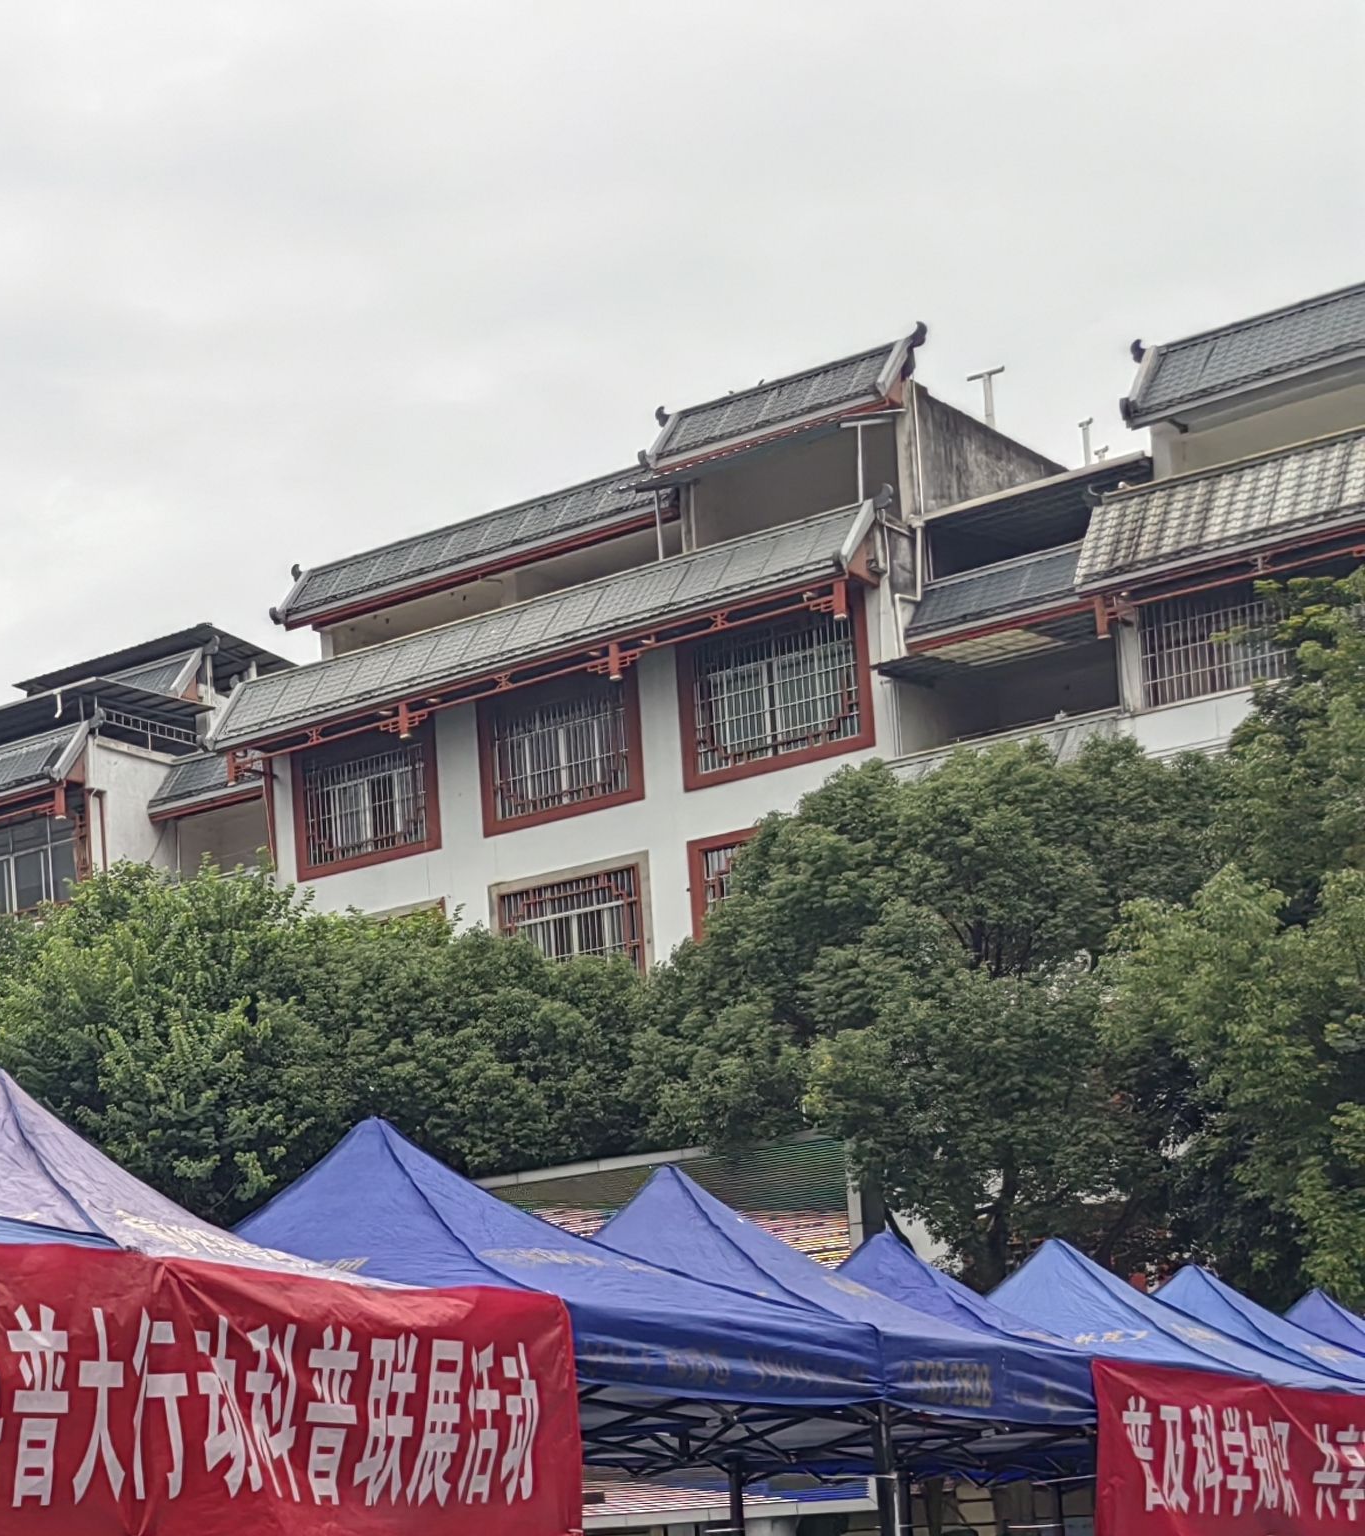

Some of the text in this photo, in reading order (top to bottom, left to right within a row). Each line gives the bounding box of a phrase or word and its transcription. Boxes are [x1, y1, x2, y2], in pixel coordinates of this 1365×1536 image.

[1121, 1395, 1301, 1518] 普及科学知识
